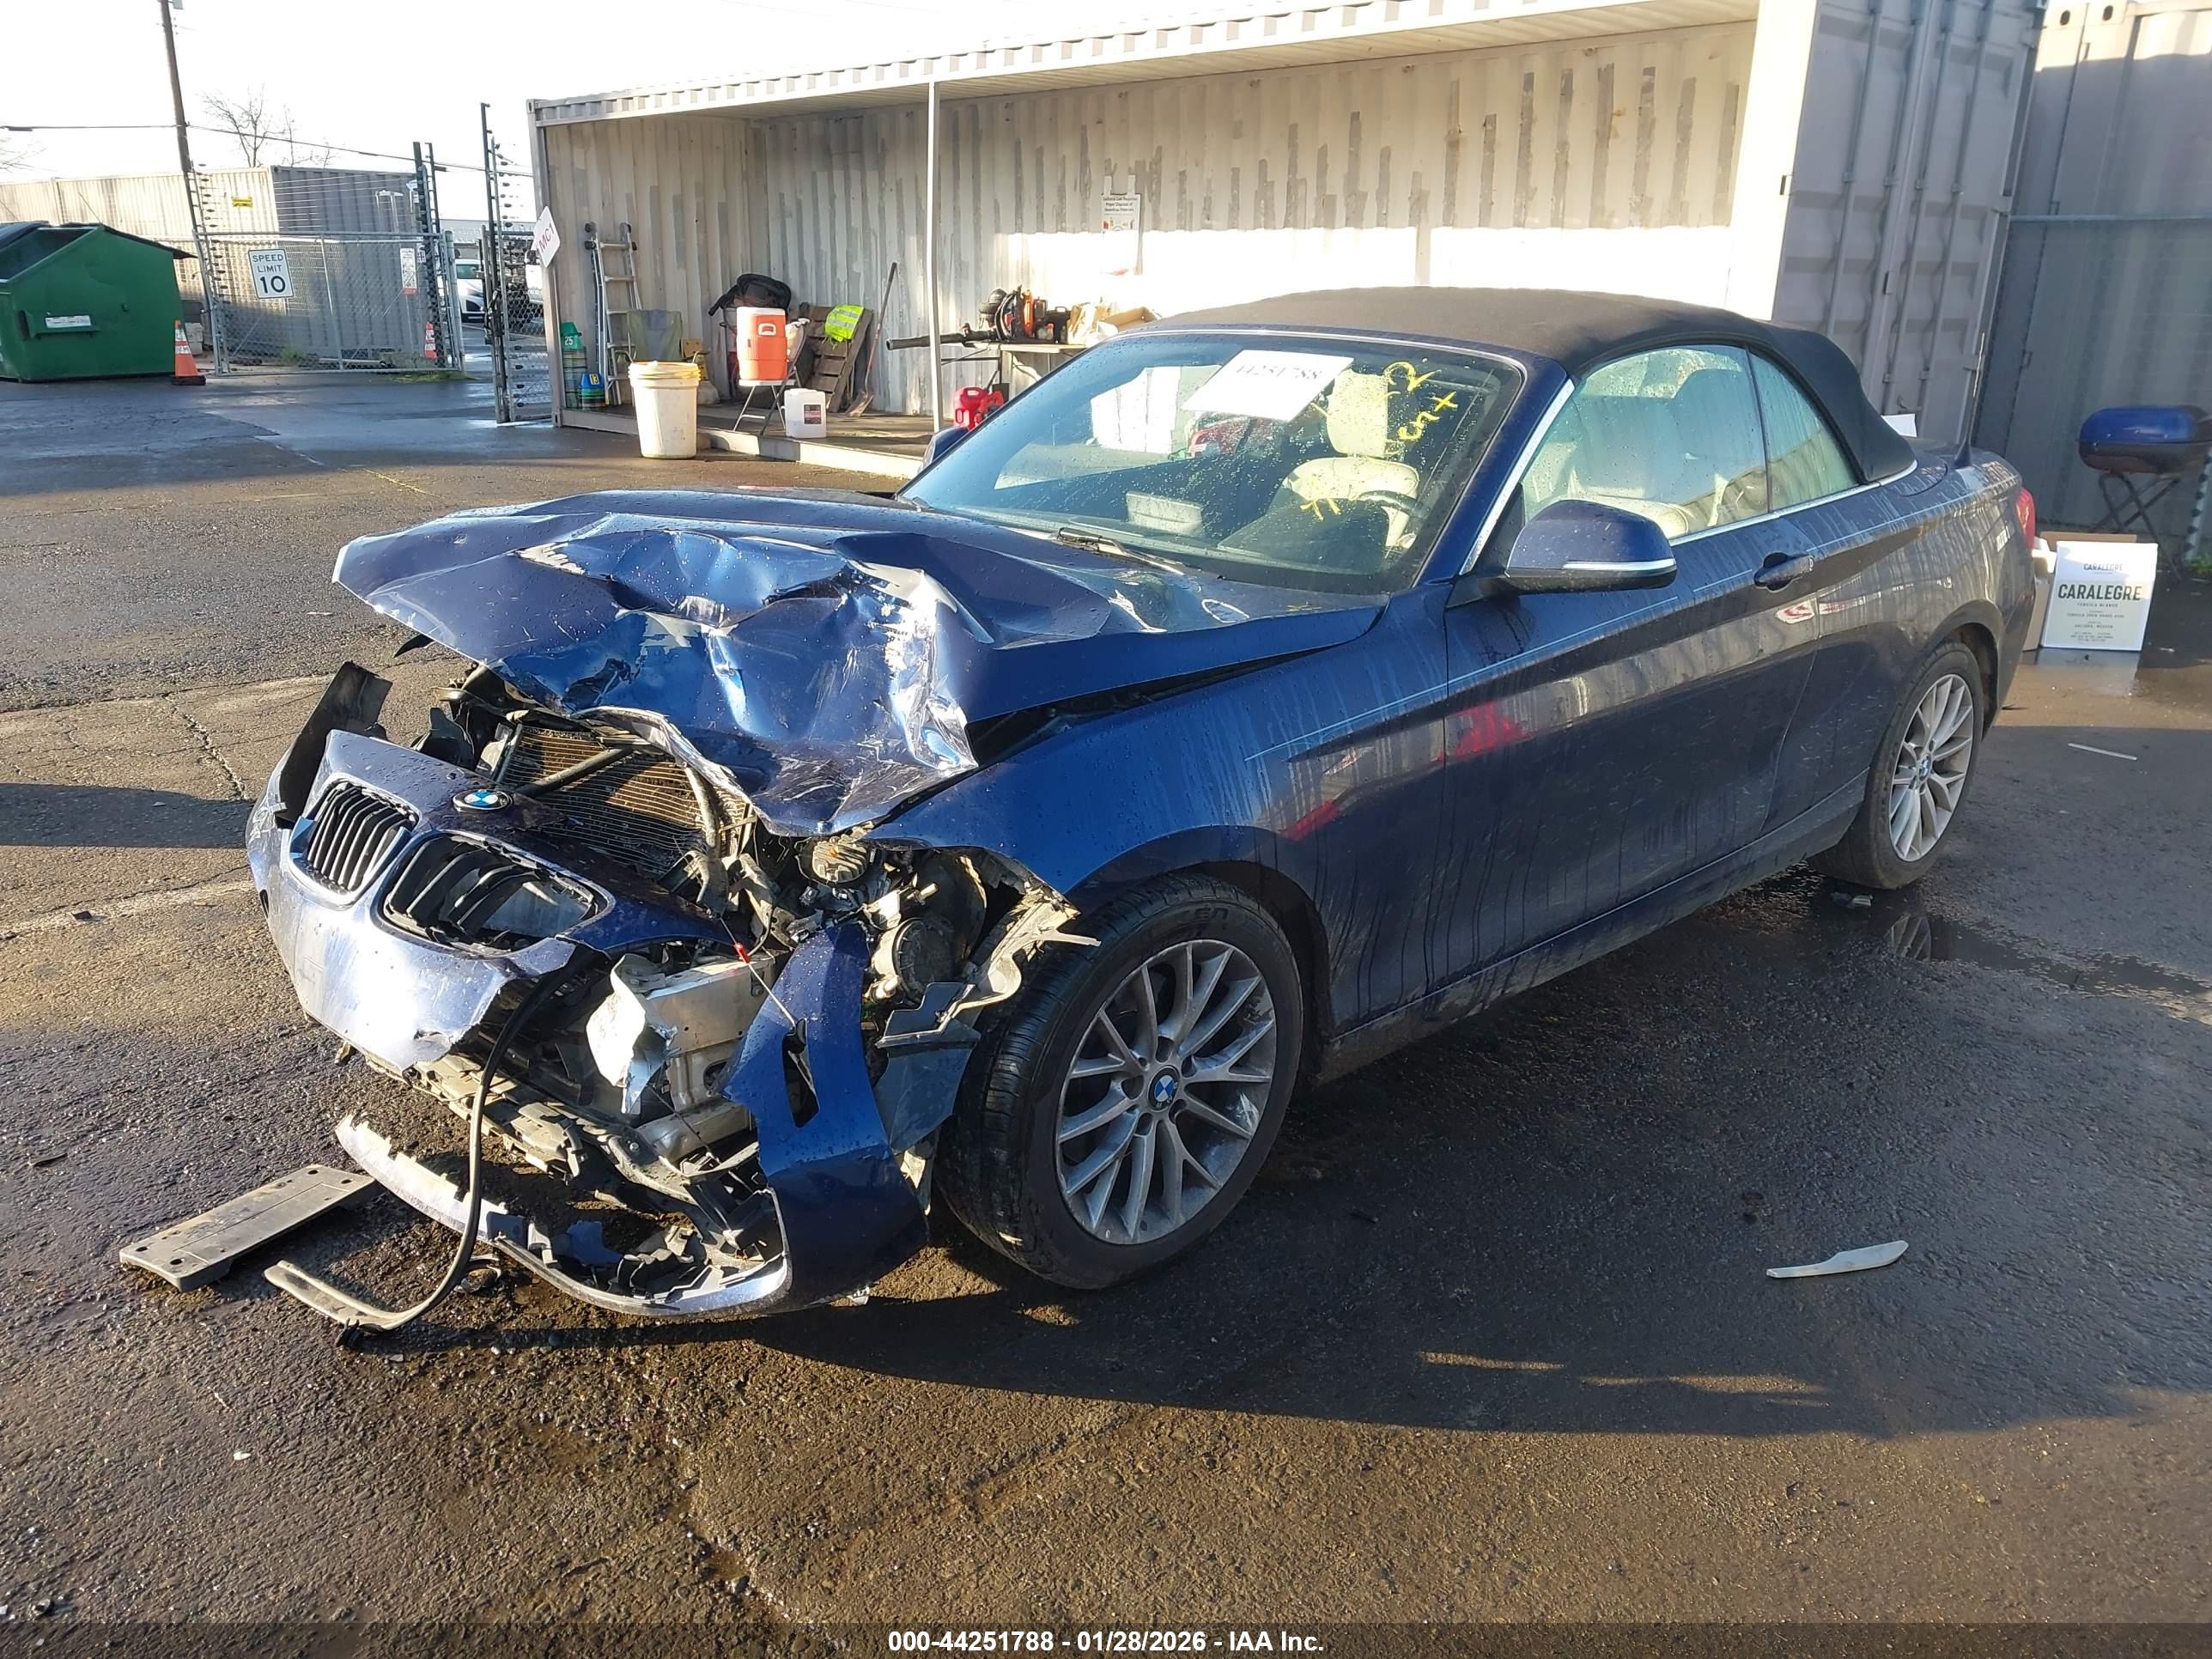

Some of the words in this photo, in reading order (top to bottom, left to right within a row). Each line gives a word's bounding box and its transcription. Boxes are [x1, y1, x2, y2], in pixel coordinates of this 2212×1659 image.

[252, 254, 284, 263] SPEED
[258, 264, 283, 273] LIMIT
[259, 275, 287, 294] 10
[564, 336, 574, 345] 25
[2083, 563, 2123, 572] CARALEGRE
[2057, 584, 2142, 600] CARALEGRE
